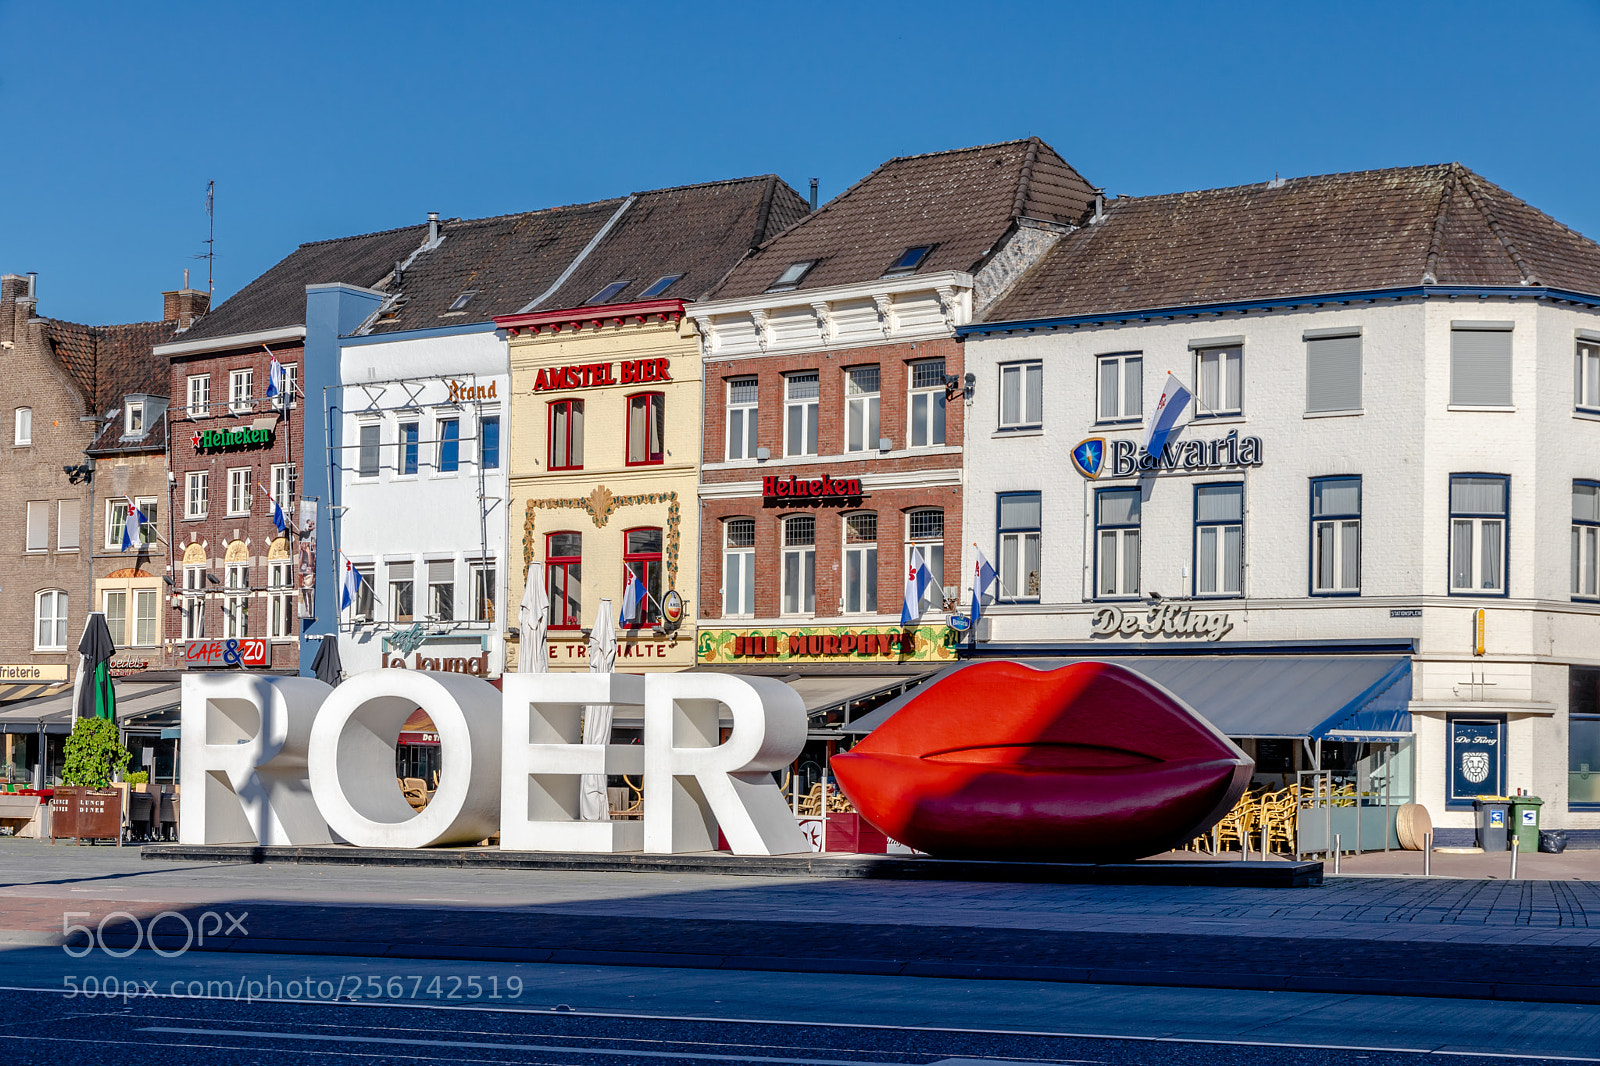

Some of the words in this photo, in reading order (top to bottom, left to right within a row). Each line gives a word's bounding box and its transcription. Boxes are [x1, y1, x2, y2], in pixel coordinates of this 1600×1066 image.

[532, 363, 615, 391] AMSTEL
[620, 357, 671, 384] BIER
[448, 380, 497, 402] Brand
[203, 427, 269, 448] Heineken
[1111, 428, 1263, 477] Bavaria
[762, 474, 861, 496] Heineken
[1090, 605, 1137, 635] De
[187, 641, 223, 665] CAFÉ
[223, 639, 245, 667] &
[243, 641, 264, 660] ZO
[734, 636, 780, 655] JILL
[788, 633, 914, 655] MURPHY'S
[178, 668, 808, 857] ROER
